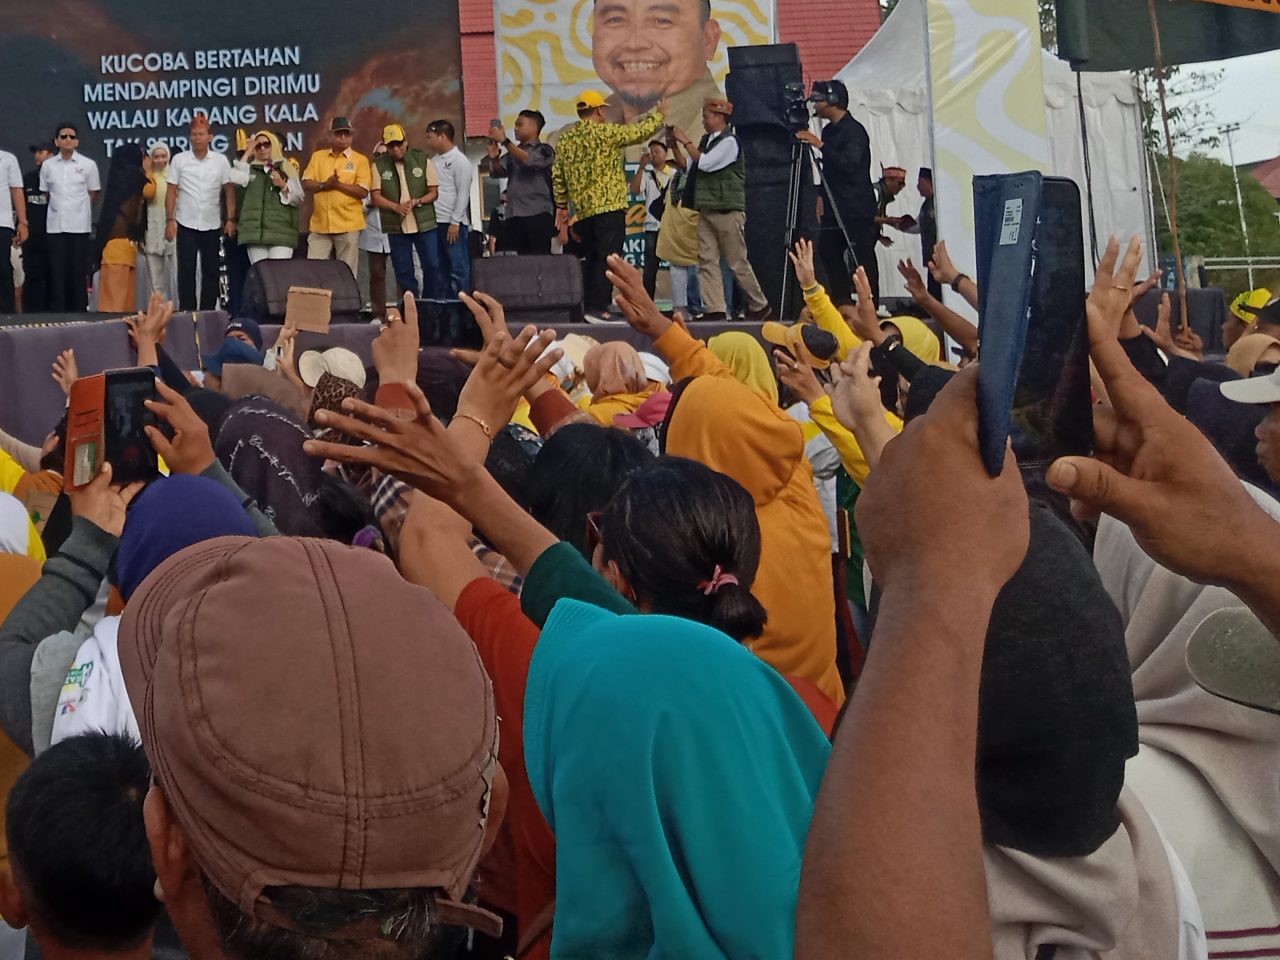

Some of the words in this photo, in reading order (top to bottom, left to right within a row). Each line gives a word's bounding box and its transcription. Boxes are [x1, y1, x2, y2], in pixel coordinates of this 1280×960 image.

[100, 52, 189, 74] KUCOBA
[195, 46, 300, 71] BERTAHAN
[83, 77, 237, 103] MENDAMPINGI
[244, 73, 321, 96] DIRIMU
[87, 108, 159, 131] WALAU
[264, 102, 319, 124] KALA
